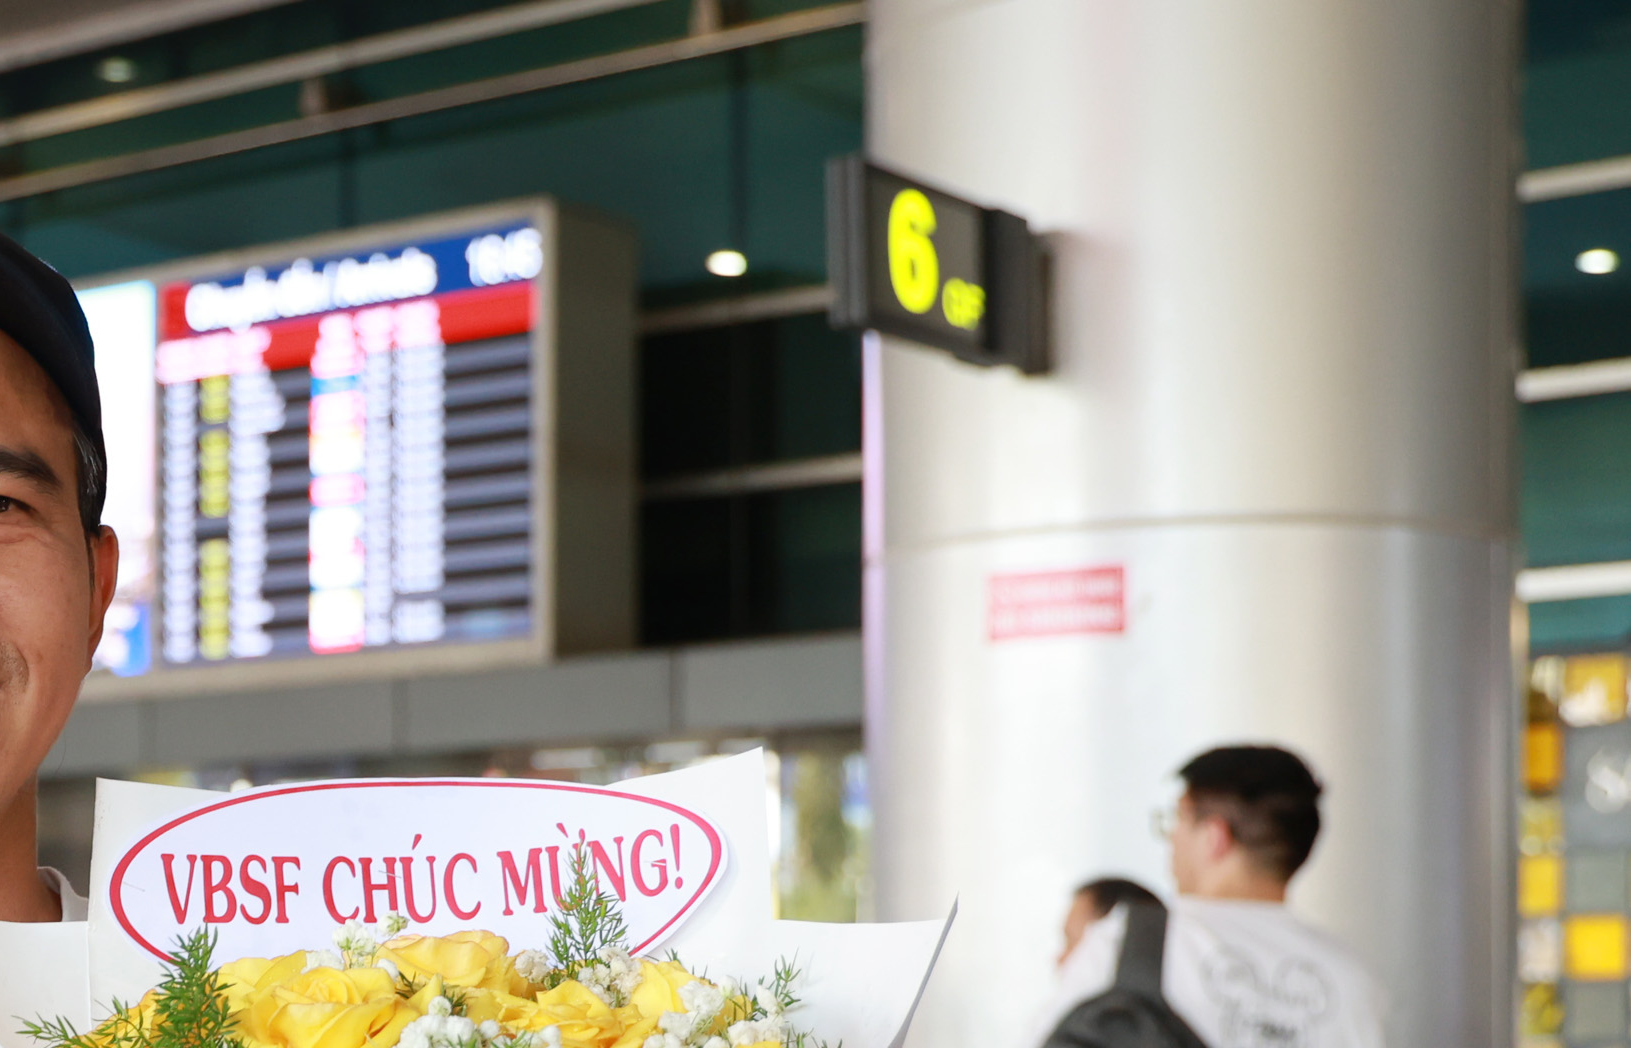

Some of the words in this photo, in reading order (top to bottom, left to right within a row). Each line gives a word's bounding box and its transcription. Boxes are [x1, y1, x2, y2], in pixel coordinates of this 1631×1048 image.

[887, 188, 939, 314] 6
[161, 854, 301, 924] VBSF
[323, 834, 481, 924] CHÚC
[497, 823, 684, 916] MỪNG!
